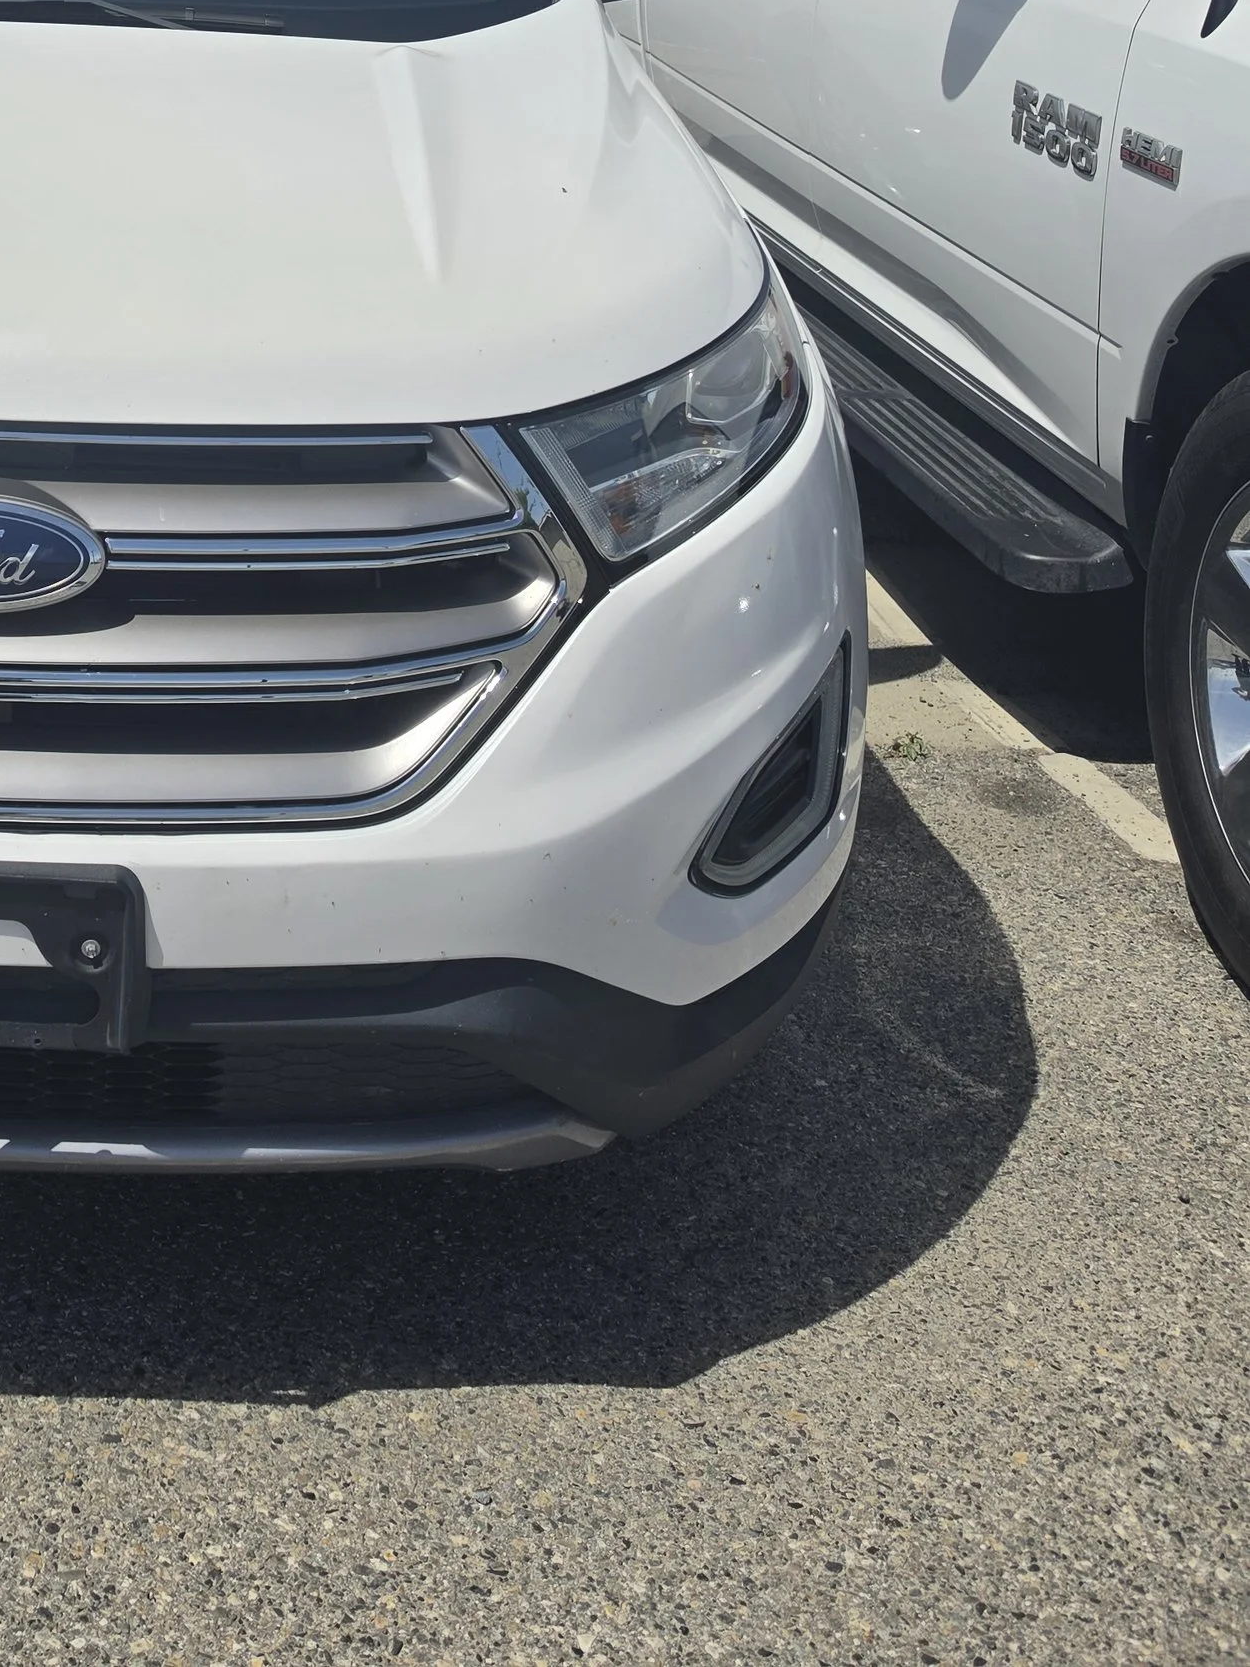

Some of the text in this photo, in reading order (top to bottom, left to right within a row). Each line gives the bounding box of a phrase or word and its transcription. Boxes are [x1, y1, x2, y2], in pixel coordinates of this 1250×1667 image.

[1013, 80, 1102, 149] RAM
[1011, 110, 1098, 179] 1500
[1121, 127, 1183, 169] HEMI
[1121, 148, 1173, 181] 5.7 LITER
